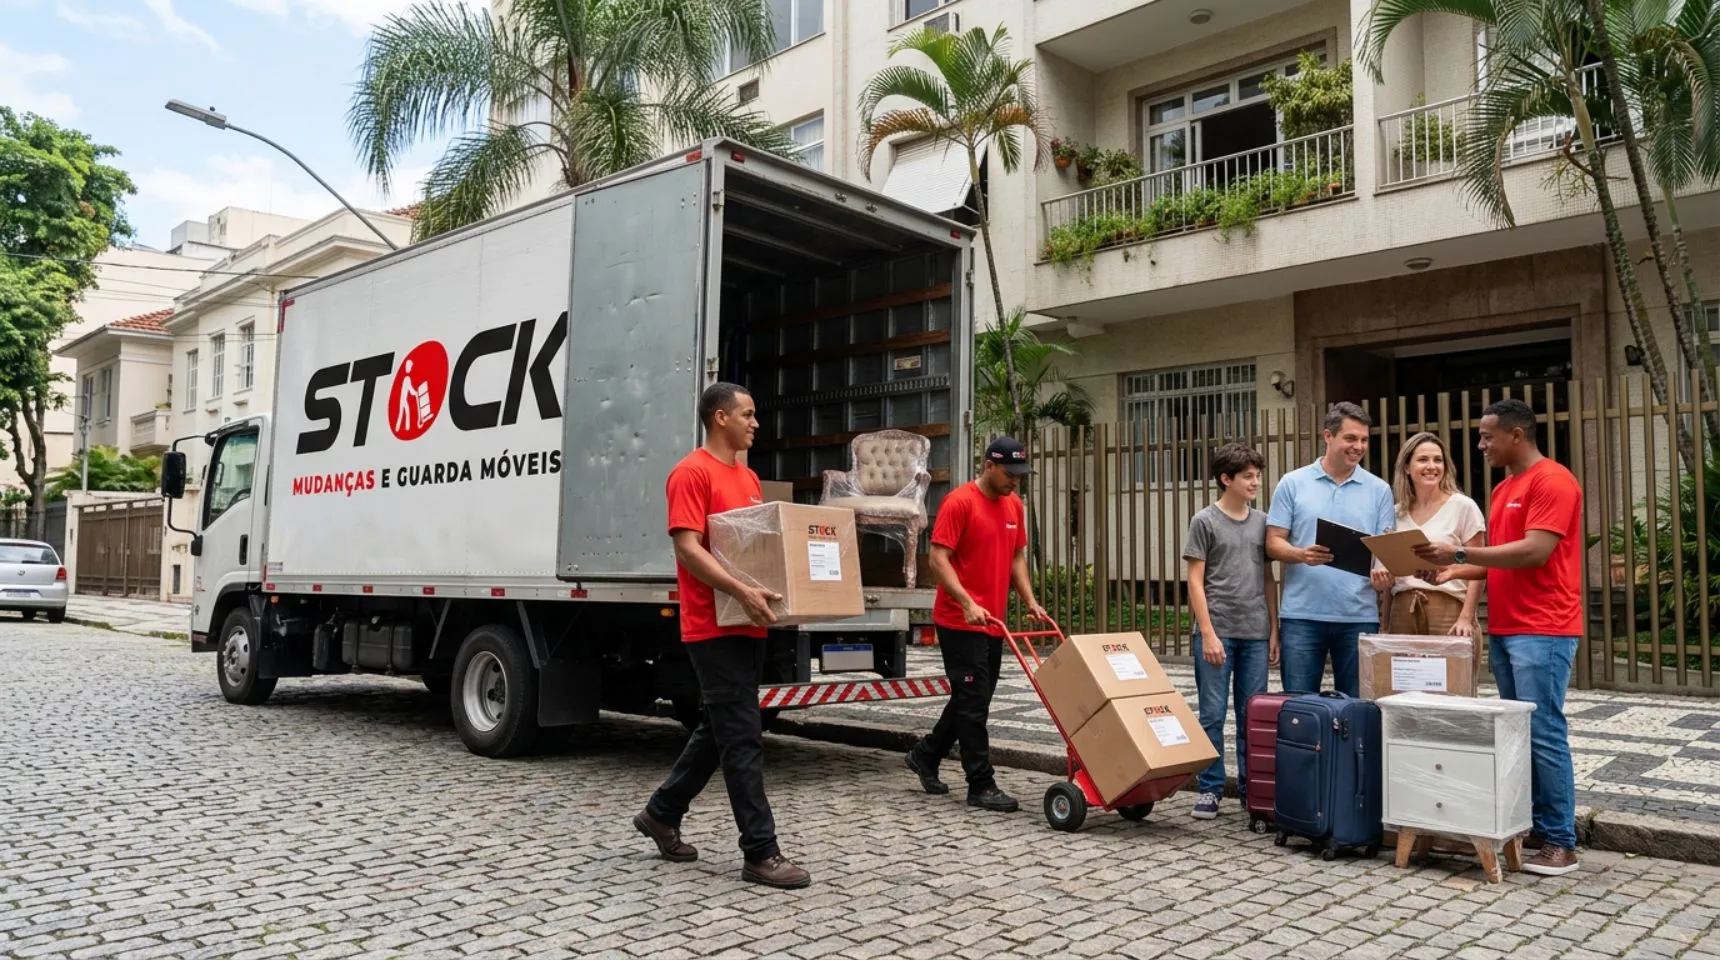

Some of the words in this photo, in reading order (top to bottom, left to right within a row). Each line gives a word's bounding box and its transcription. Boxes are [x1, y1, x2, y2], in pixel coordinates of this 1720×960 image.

[296, 311, 568, 455] STOCK
[293, 470, 375, 497] MUDANÇAS
[381, 468, 391, 488] E
[397, 461, 472, 487] GUARDA
[480, 449, 562, 480] MÓVEIS
